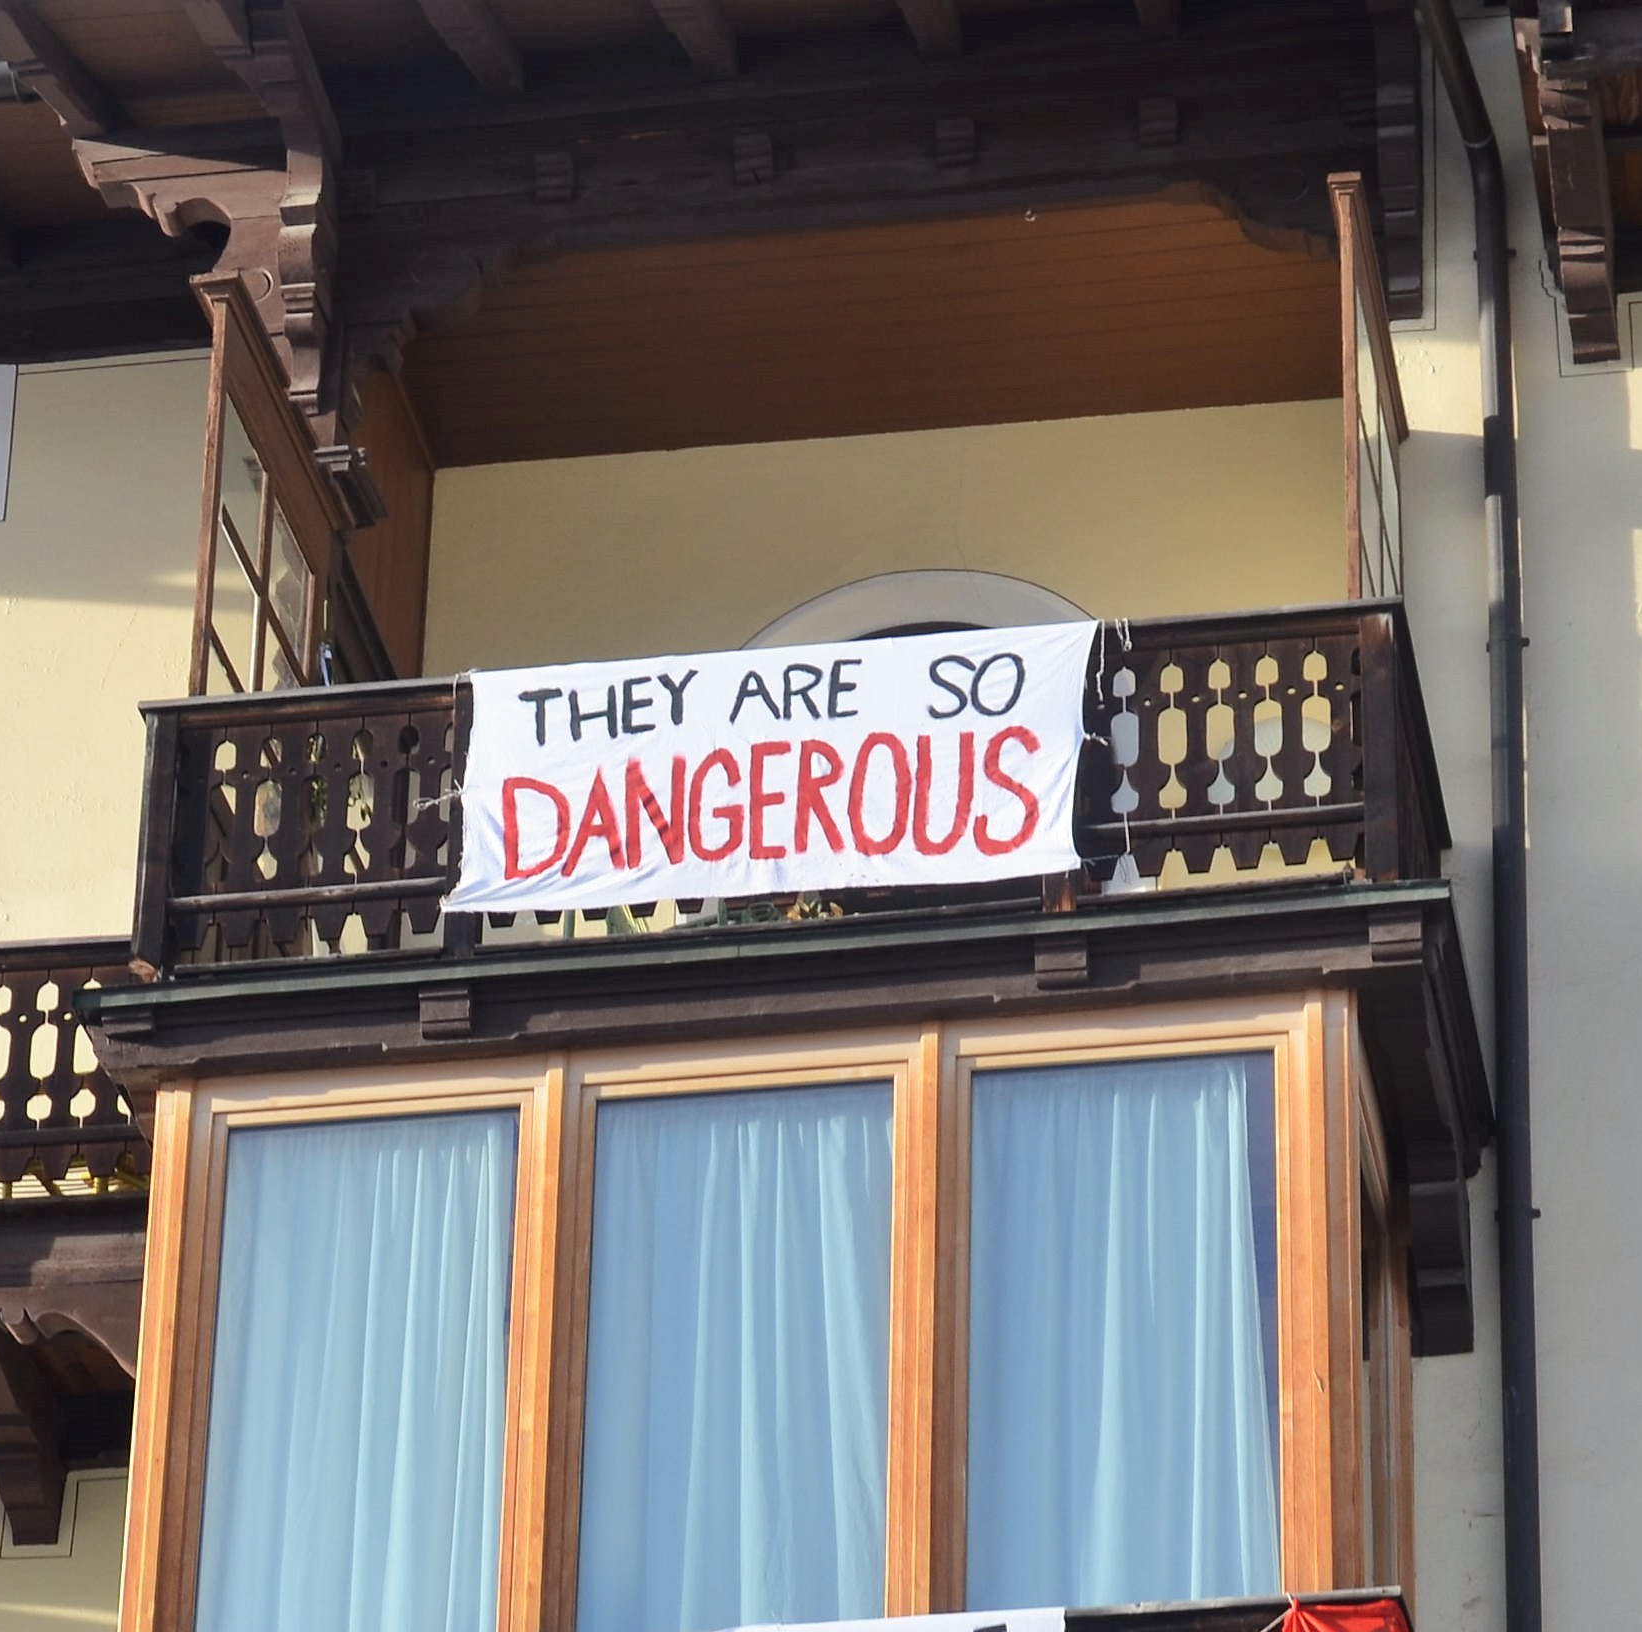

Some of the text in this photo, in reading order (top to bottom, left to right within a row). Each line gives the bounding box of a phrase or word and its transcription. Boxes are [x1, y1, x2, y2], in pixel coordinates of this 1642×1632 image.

[519, 652, 1025, 746] THEY ARE SO
[502, 725, 1039, 880] DANGEROUS
